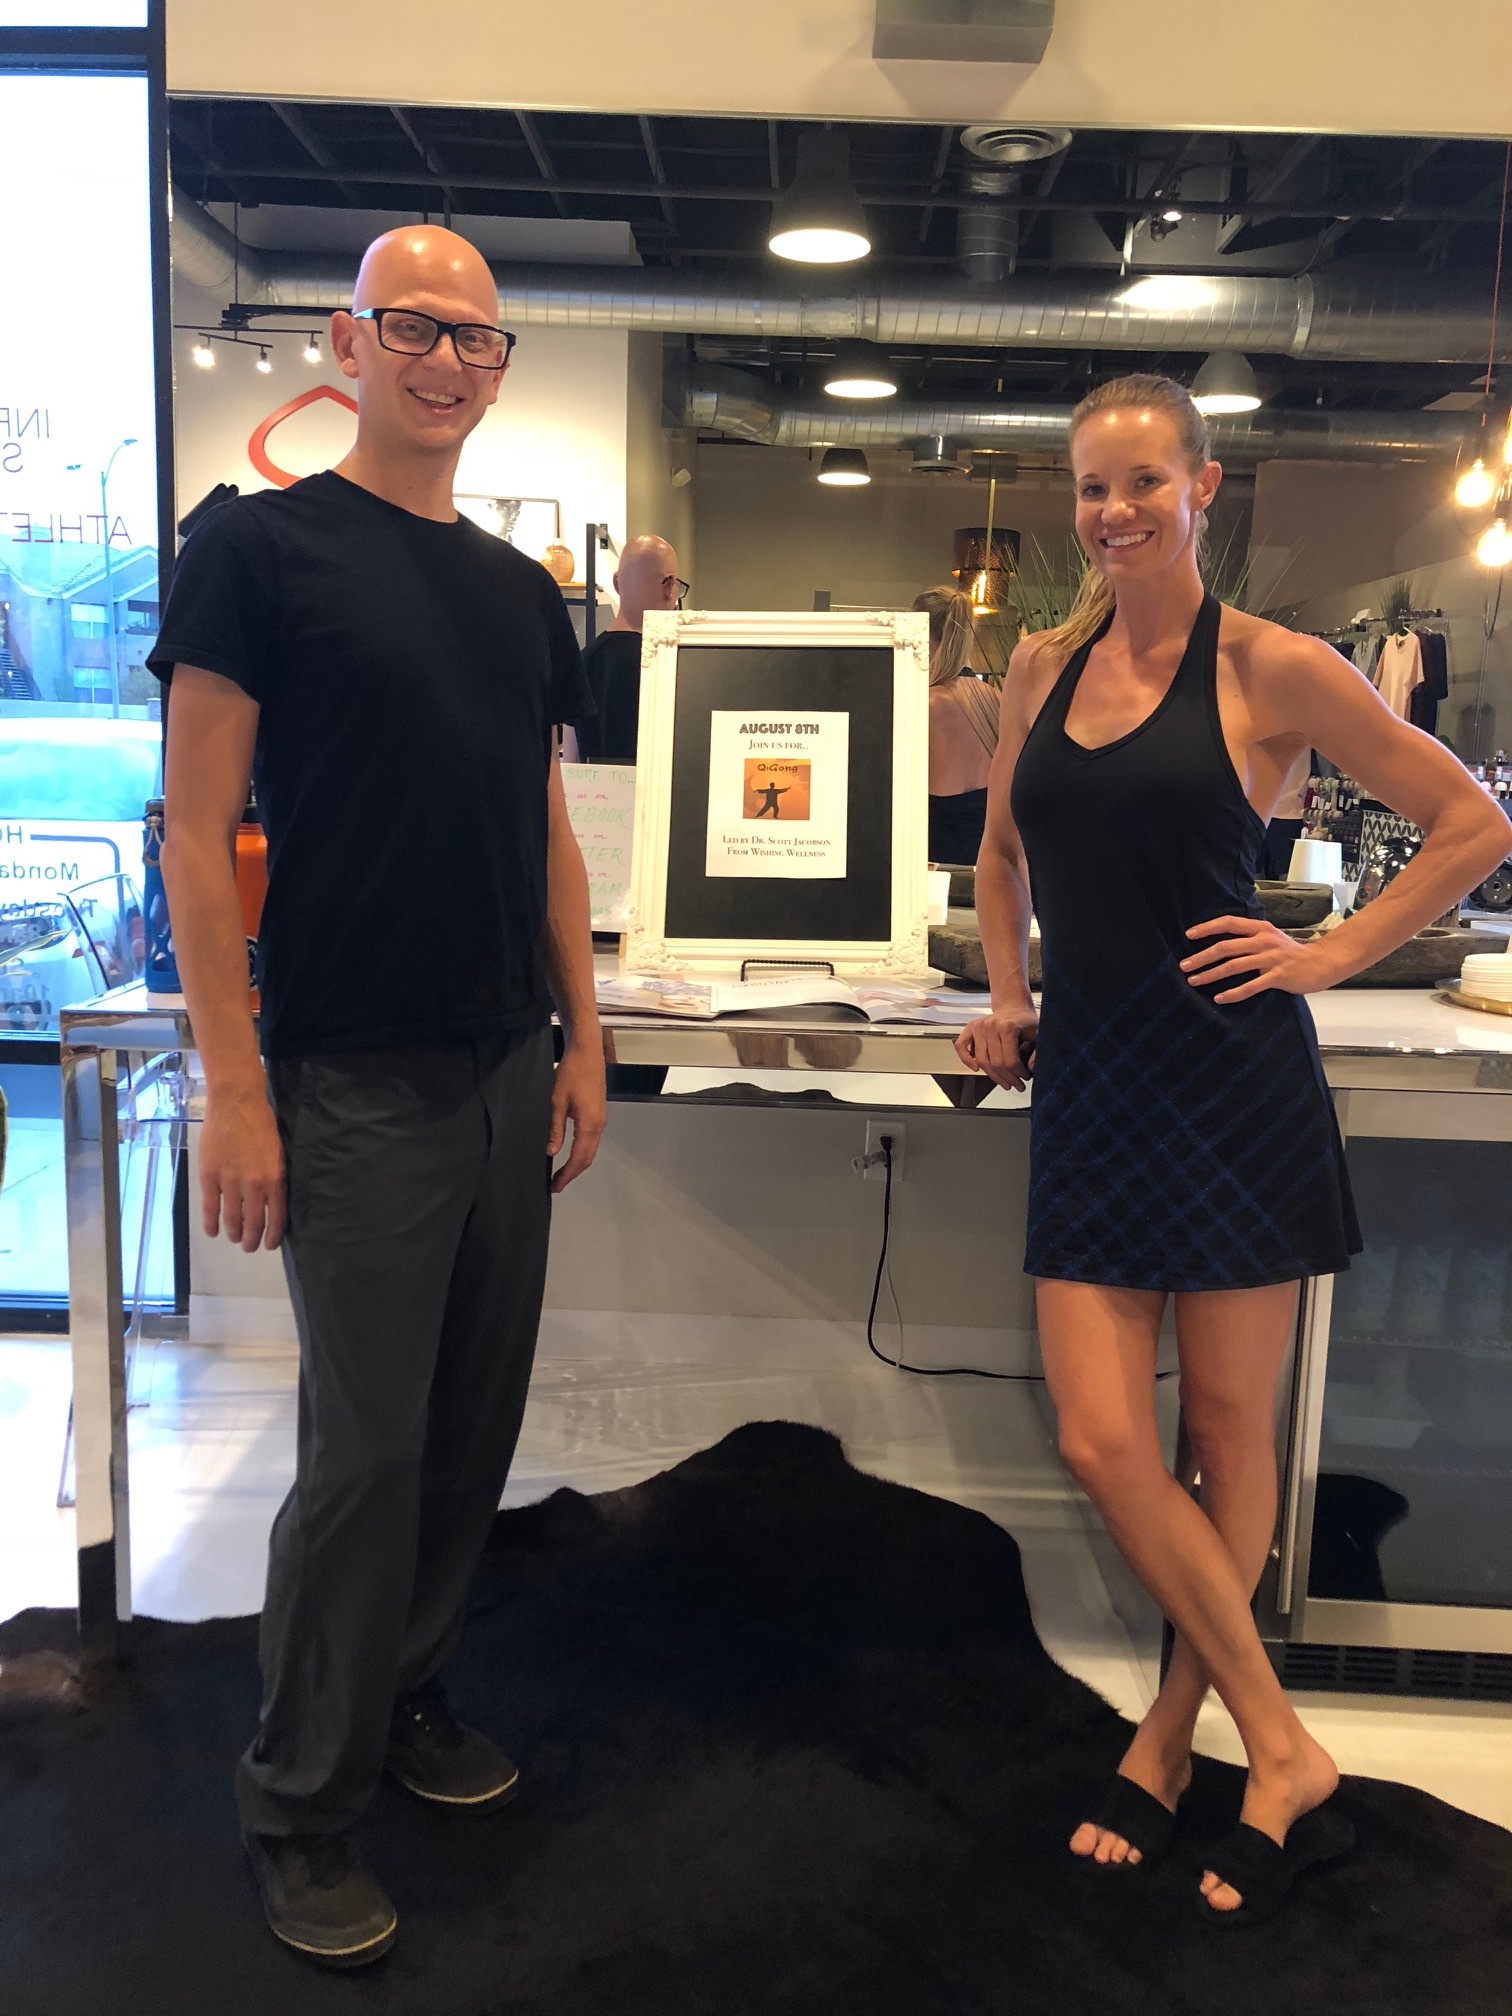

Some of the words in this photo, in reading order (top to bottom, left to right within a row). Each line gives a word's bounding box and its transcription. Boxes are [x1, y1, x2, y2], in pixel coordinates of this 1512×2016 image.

[739, 723, 792, 734] AUGUST
[795, 723, 820, 734] 8TH
[757, 763, 798, 773] QiGong
[566, 768, 600, 784] SURE
